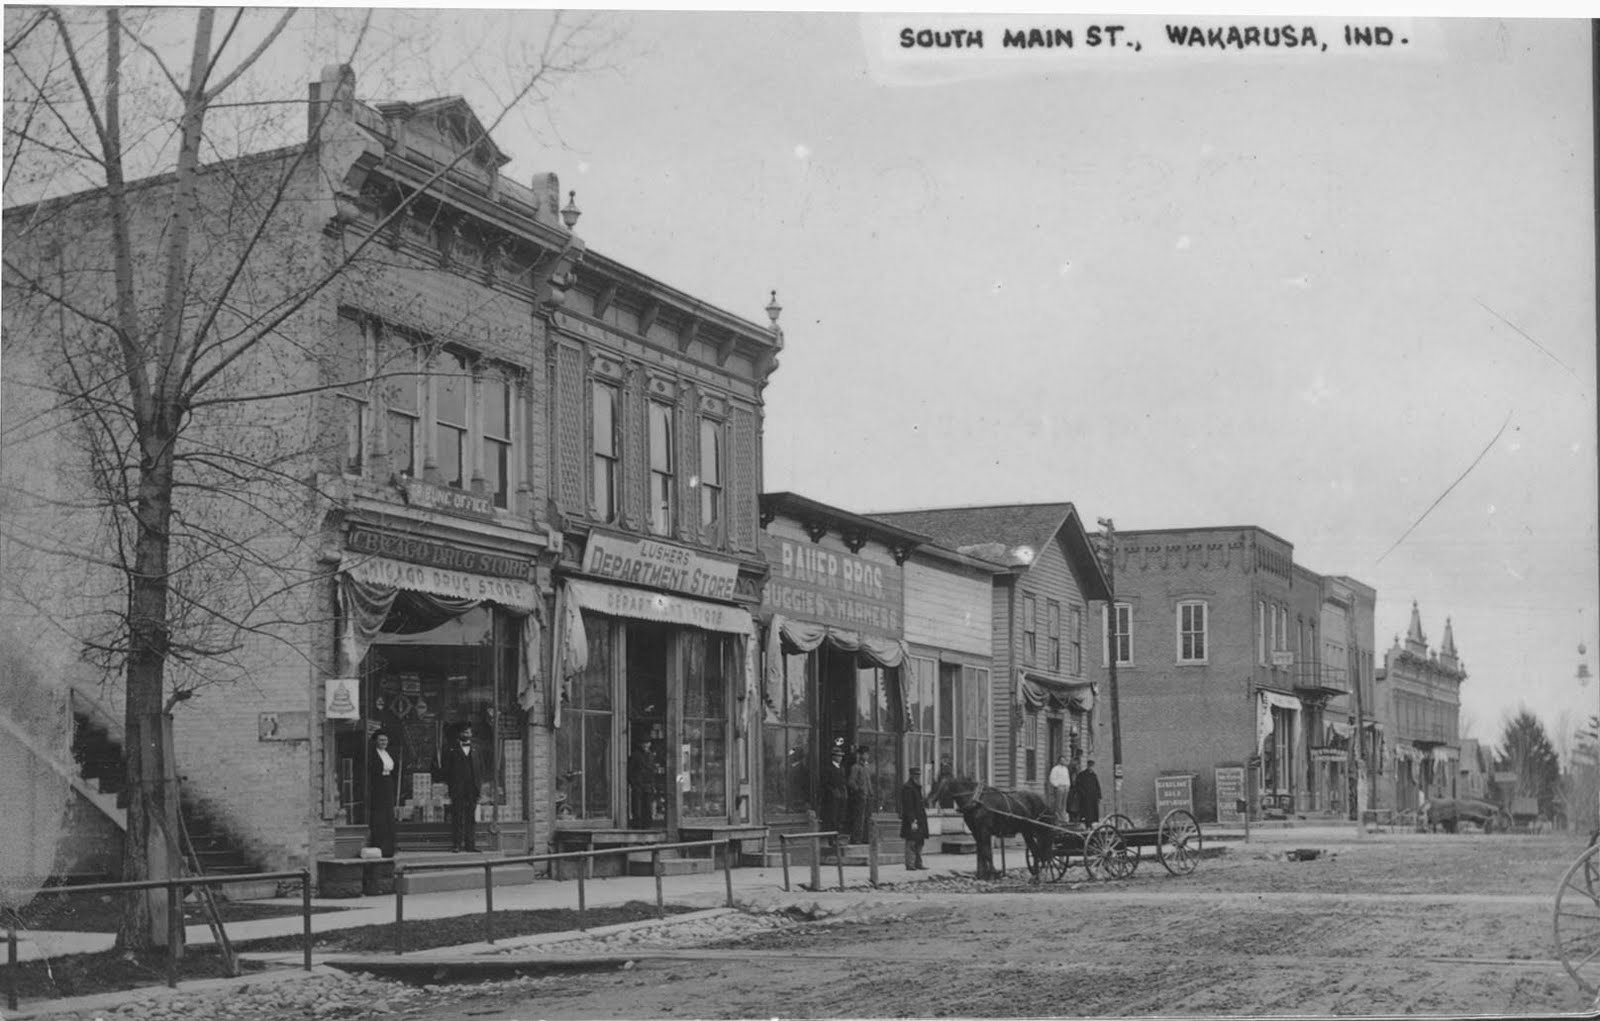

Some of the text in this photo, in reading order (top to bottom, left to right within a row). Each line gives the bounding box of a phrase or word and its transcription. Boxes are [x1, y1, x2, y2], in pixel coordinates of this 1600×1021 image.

[432, 547, 476, 569] DRUG
[479, 554, 530, 577] STORE
[640, 542, 690, 566] LUSHERS
[782, 542, 837, 589] BAUER
[433, 571, 471, 594] DRUG
[478, 580, 521, 599] STORE
[589, 545, 735, 599] DEPARTMENT STORE
